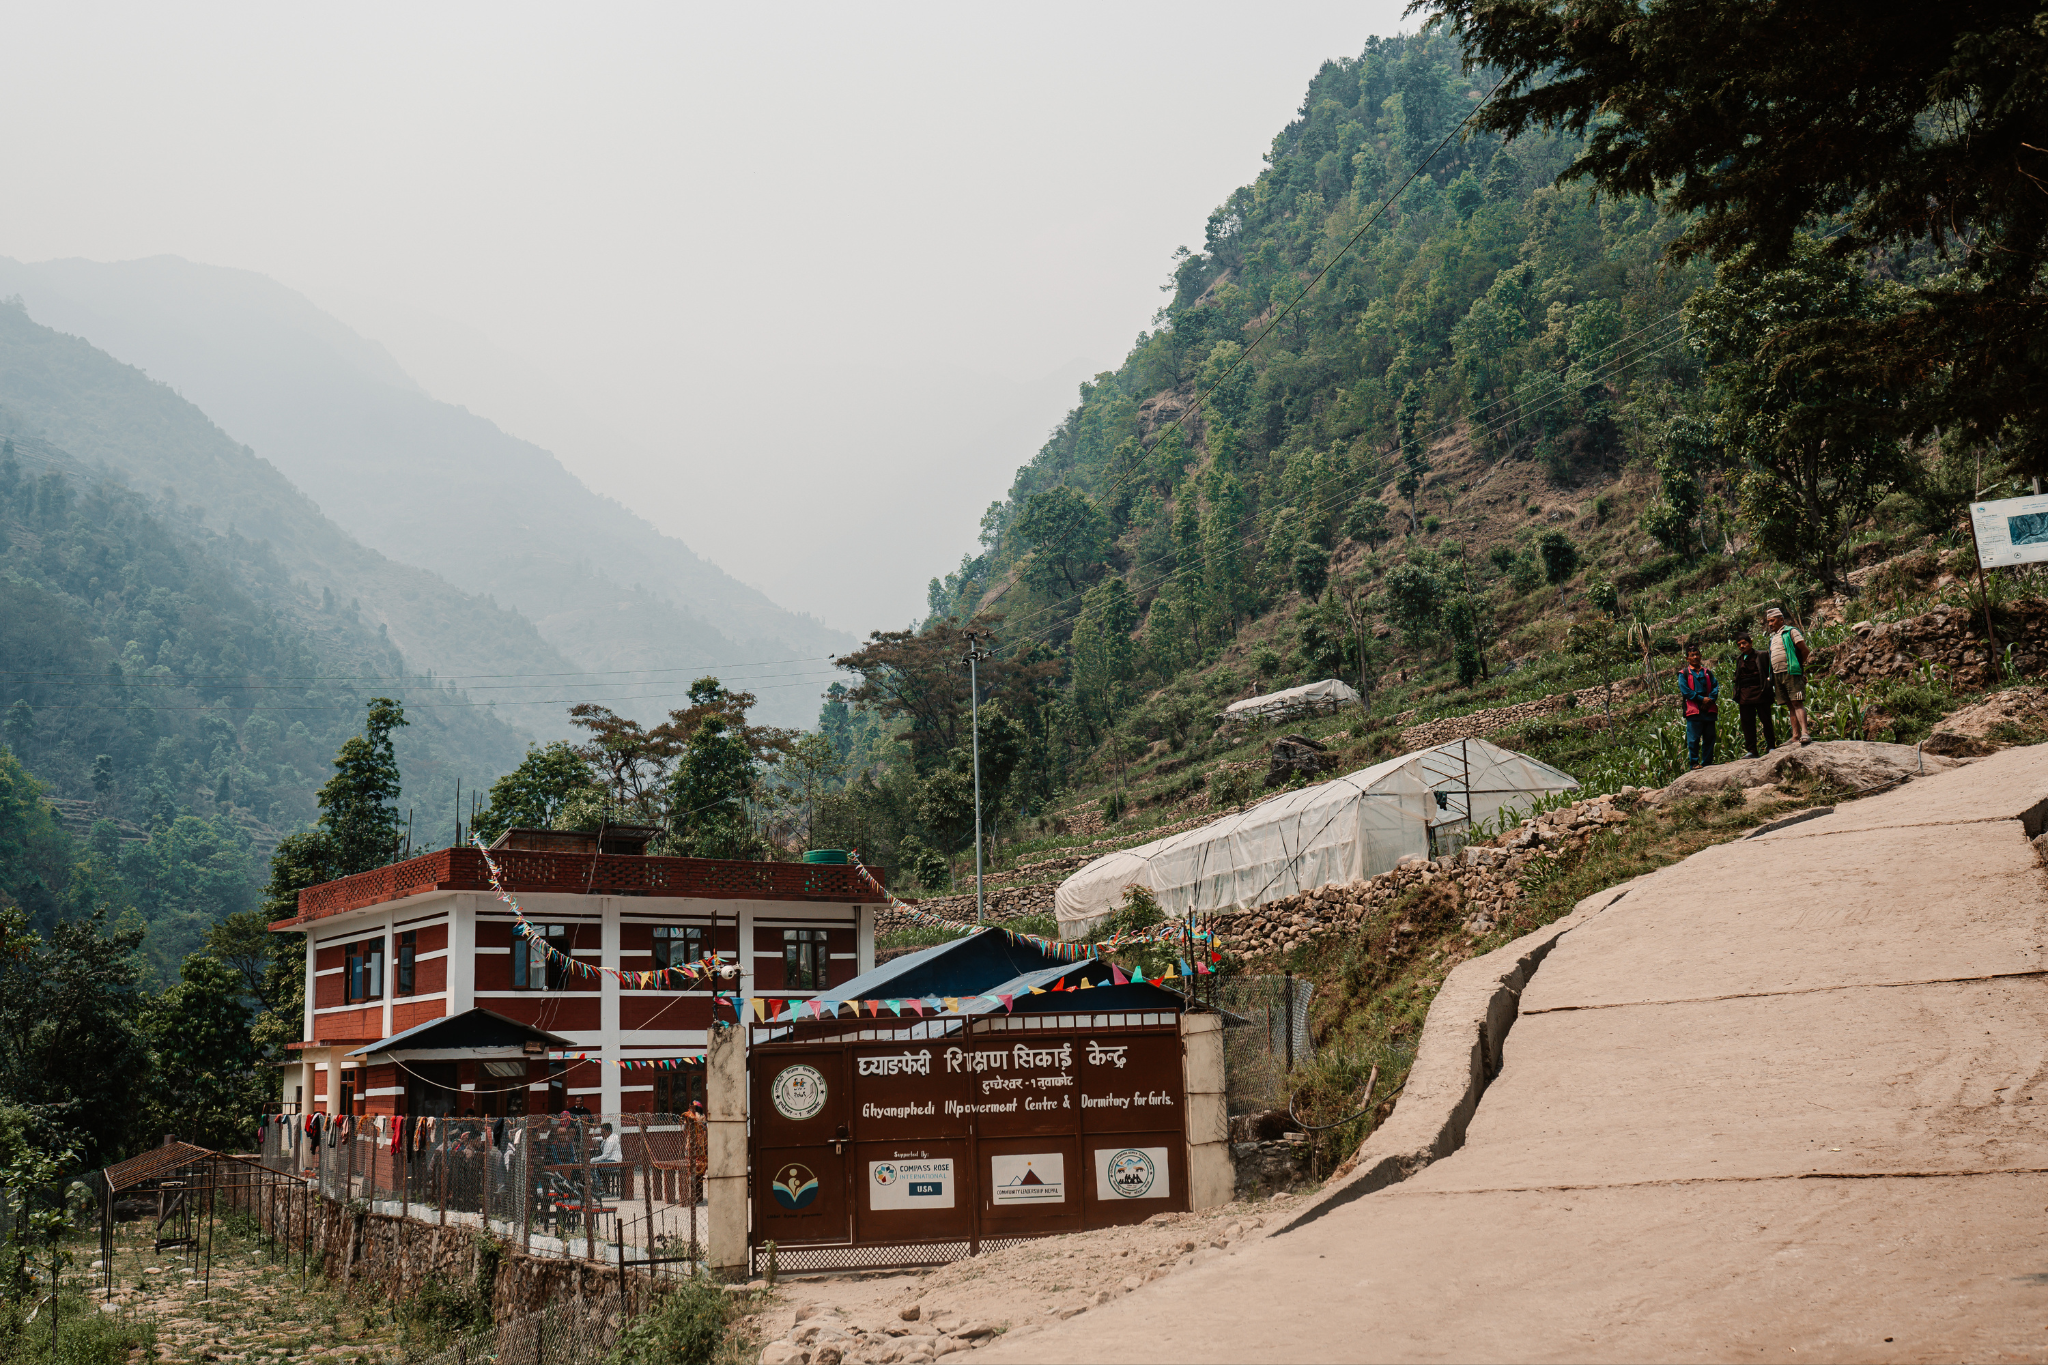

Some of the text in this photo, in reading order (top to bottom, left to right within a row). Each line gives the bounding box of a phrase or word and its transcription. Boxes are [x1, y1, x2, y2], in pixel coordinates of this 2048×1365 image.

[943, 1046, 1009, 1074] शिक्षण
[1085, 1040, 1128, 1069] केन्द्र
[1036, 1072, 1074, 1090] नुवाकोट
[862, 1101, 935, 1119] Ghyangphedi
[1024, 1096, 1058, 1111] Centre
[1062, 1094, 1071, 1109] &
[1081, 1092, 1130, 1109] Dormitory
[1133, 1091, 1147, 1106] for
[899, 1163, 950, 1172] COMPASS ROSE
[899, 1172, 947, 1180] INTERNATIONAL
[916, 1185, 933, 1193] USA
